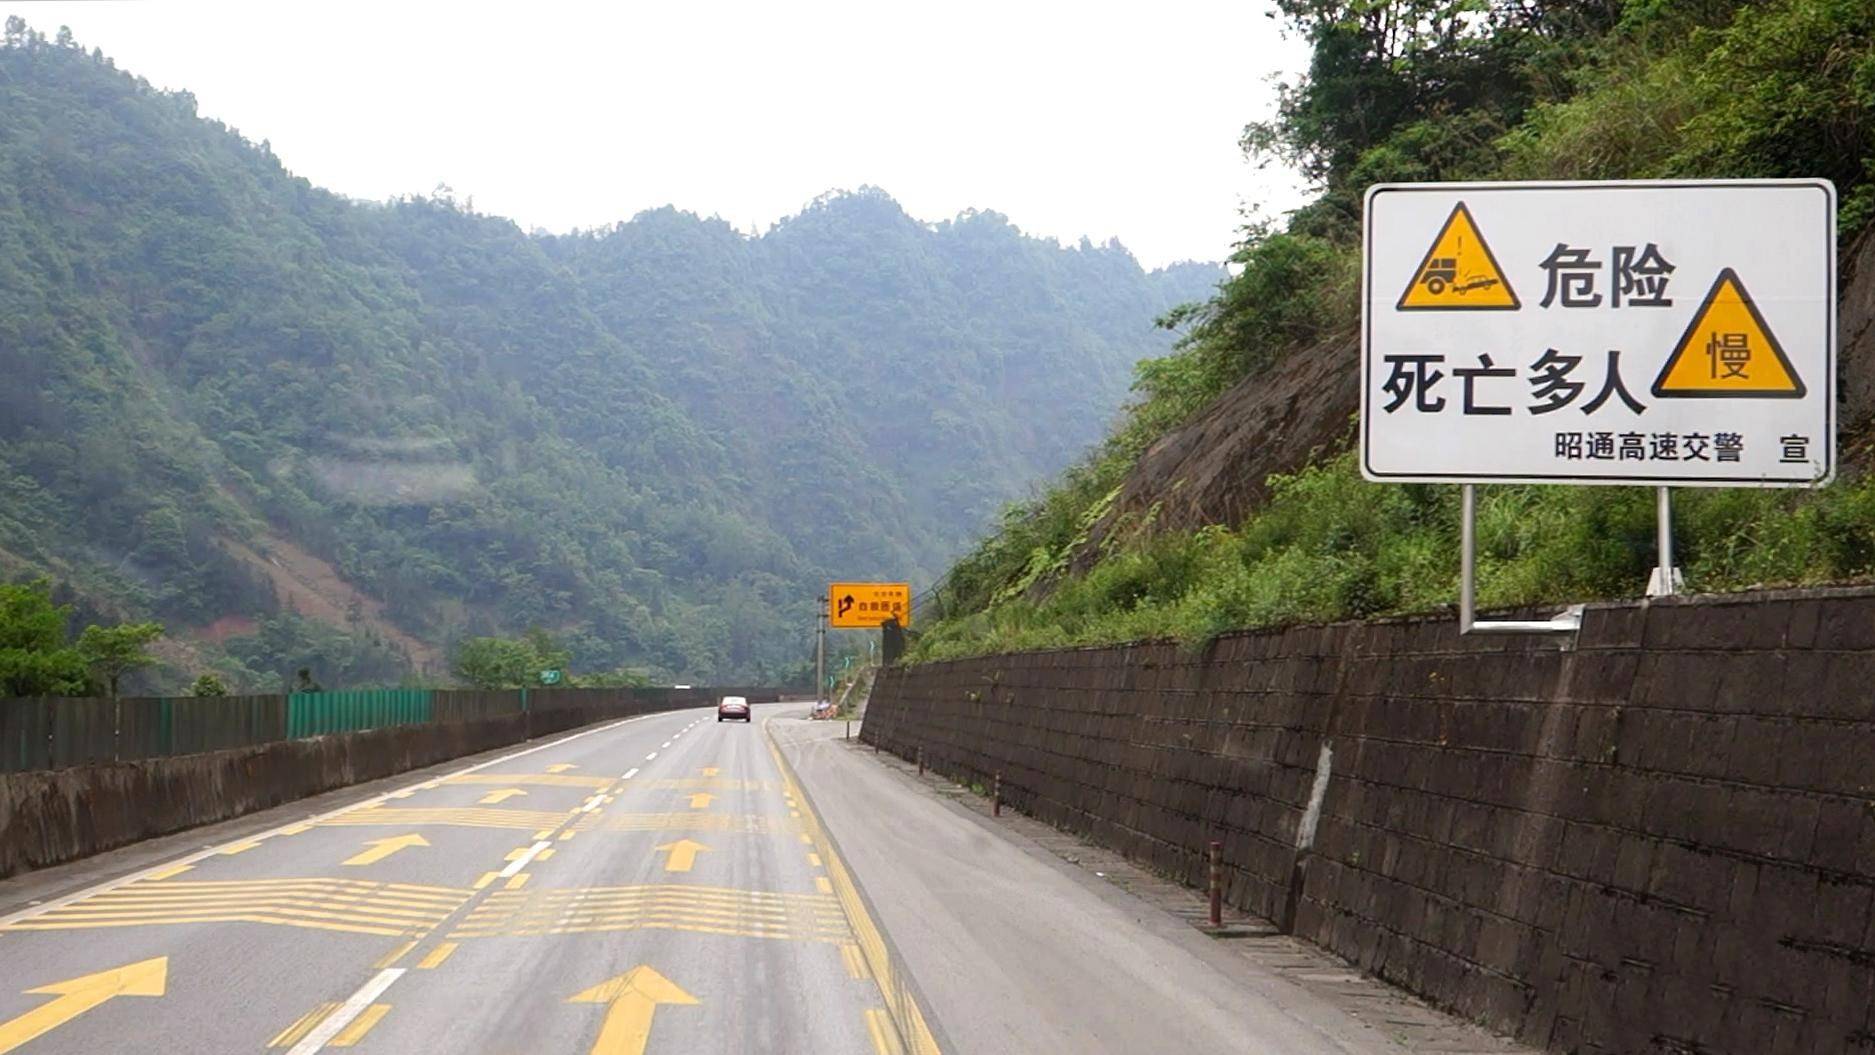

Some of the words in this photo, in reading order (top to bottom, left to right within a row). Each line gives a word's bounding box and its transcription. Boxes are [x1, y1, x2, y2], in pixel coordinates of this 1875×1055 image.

[1539, 243, 1676, 308] 危险
[1382, 348, 1647, 415] 死亡多人
[1706, 331, 1751, 380] 慢
[1555, 431, 1743, 462] 昭通高速交警
[1779, 434, 1810, 463] 宣
